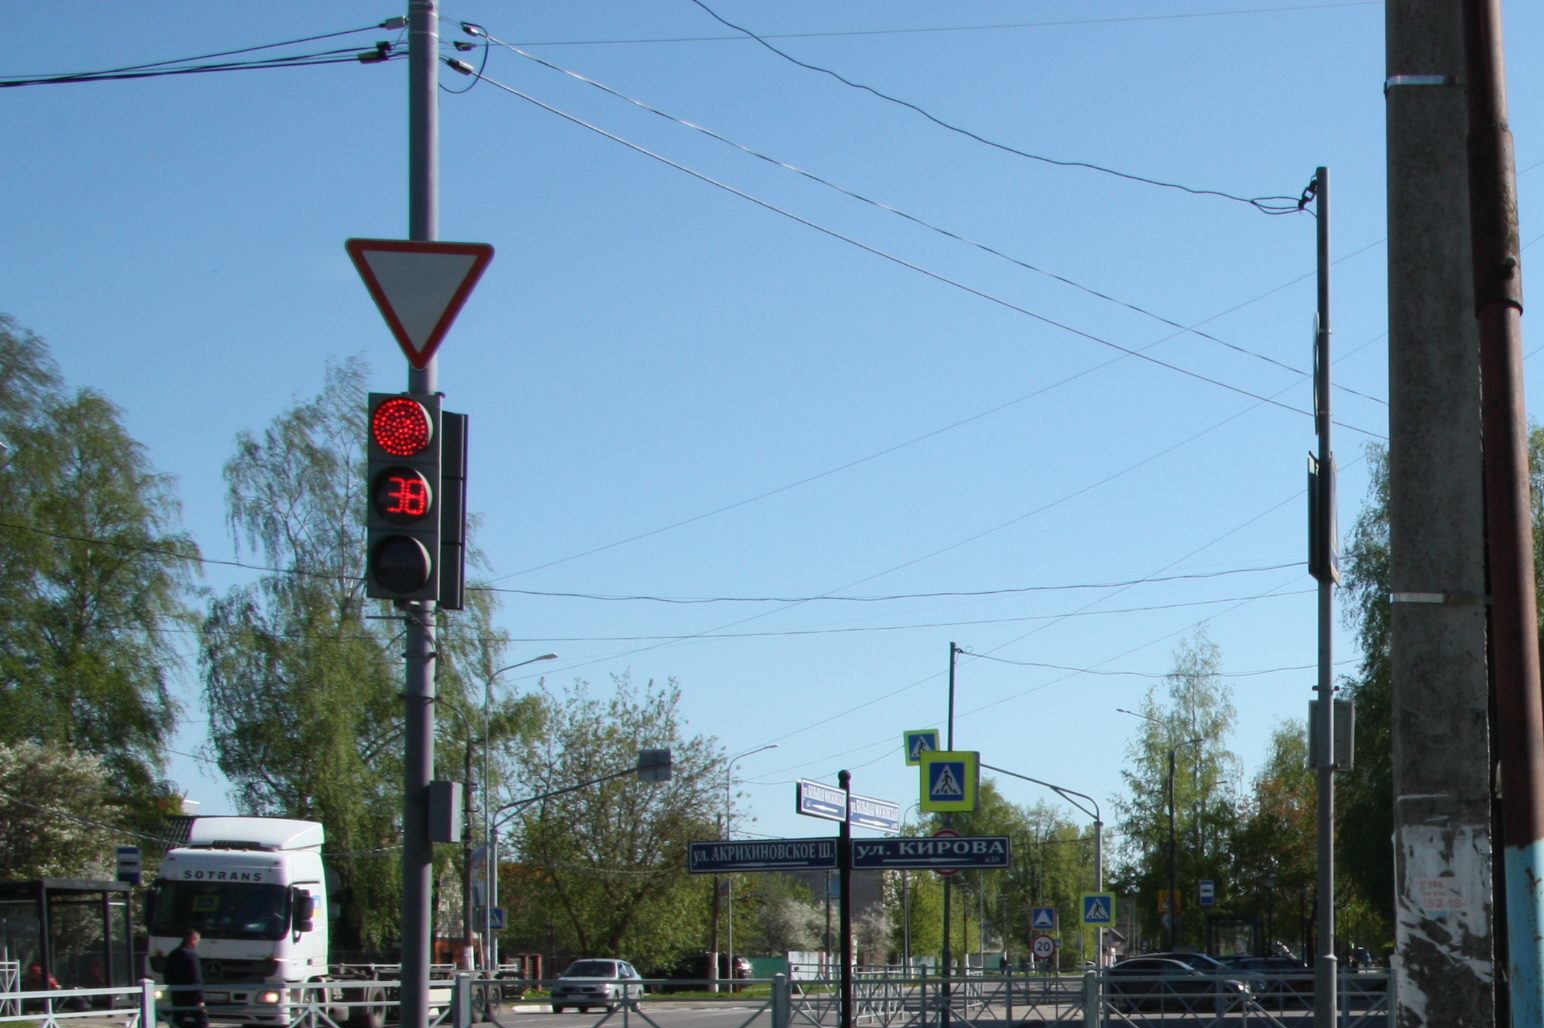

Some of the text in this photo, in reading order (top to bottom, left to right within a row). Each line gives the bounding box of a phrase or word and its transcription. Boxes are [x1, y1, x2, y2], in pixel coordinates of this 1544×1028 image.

[387, 477, 425, 515] 38
[693, 842, 834, 865] ул. АКРИХИНОВСКОЕ Ш.
[857, 841, 1005, 859] ул. КИРОВА
[184, 870, 262, 882] SOTRANS
[1036, 942, 1051, 952] 20
